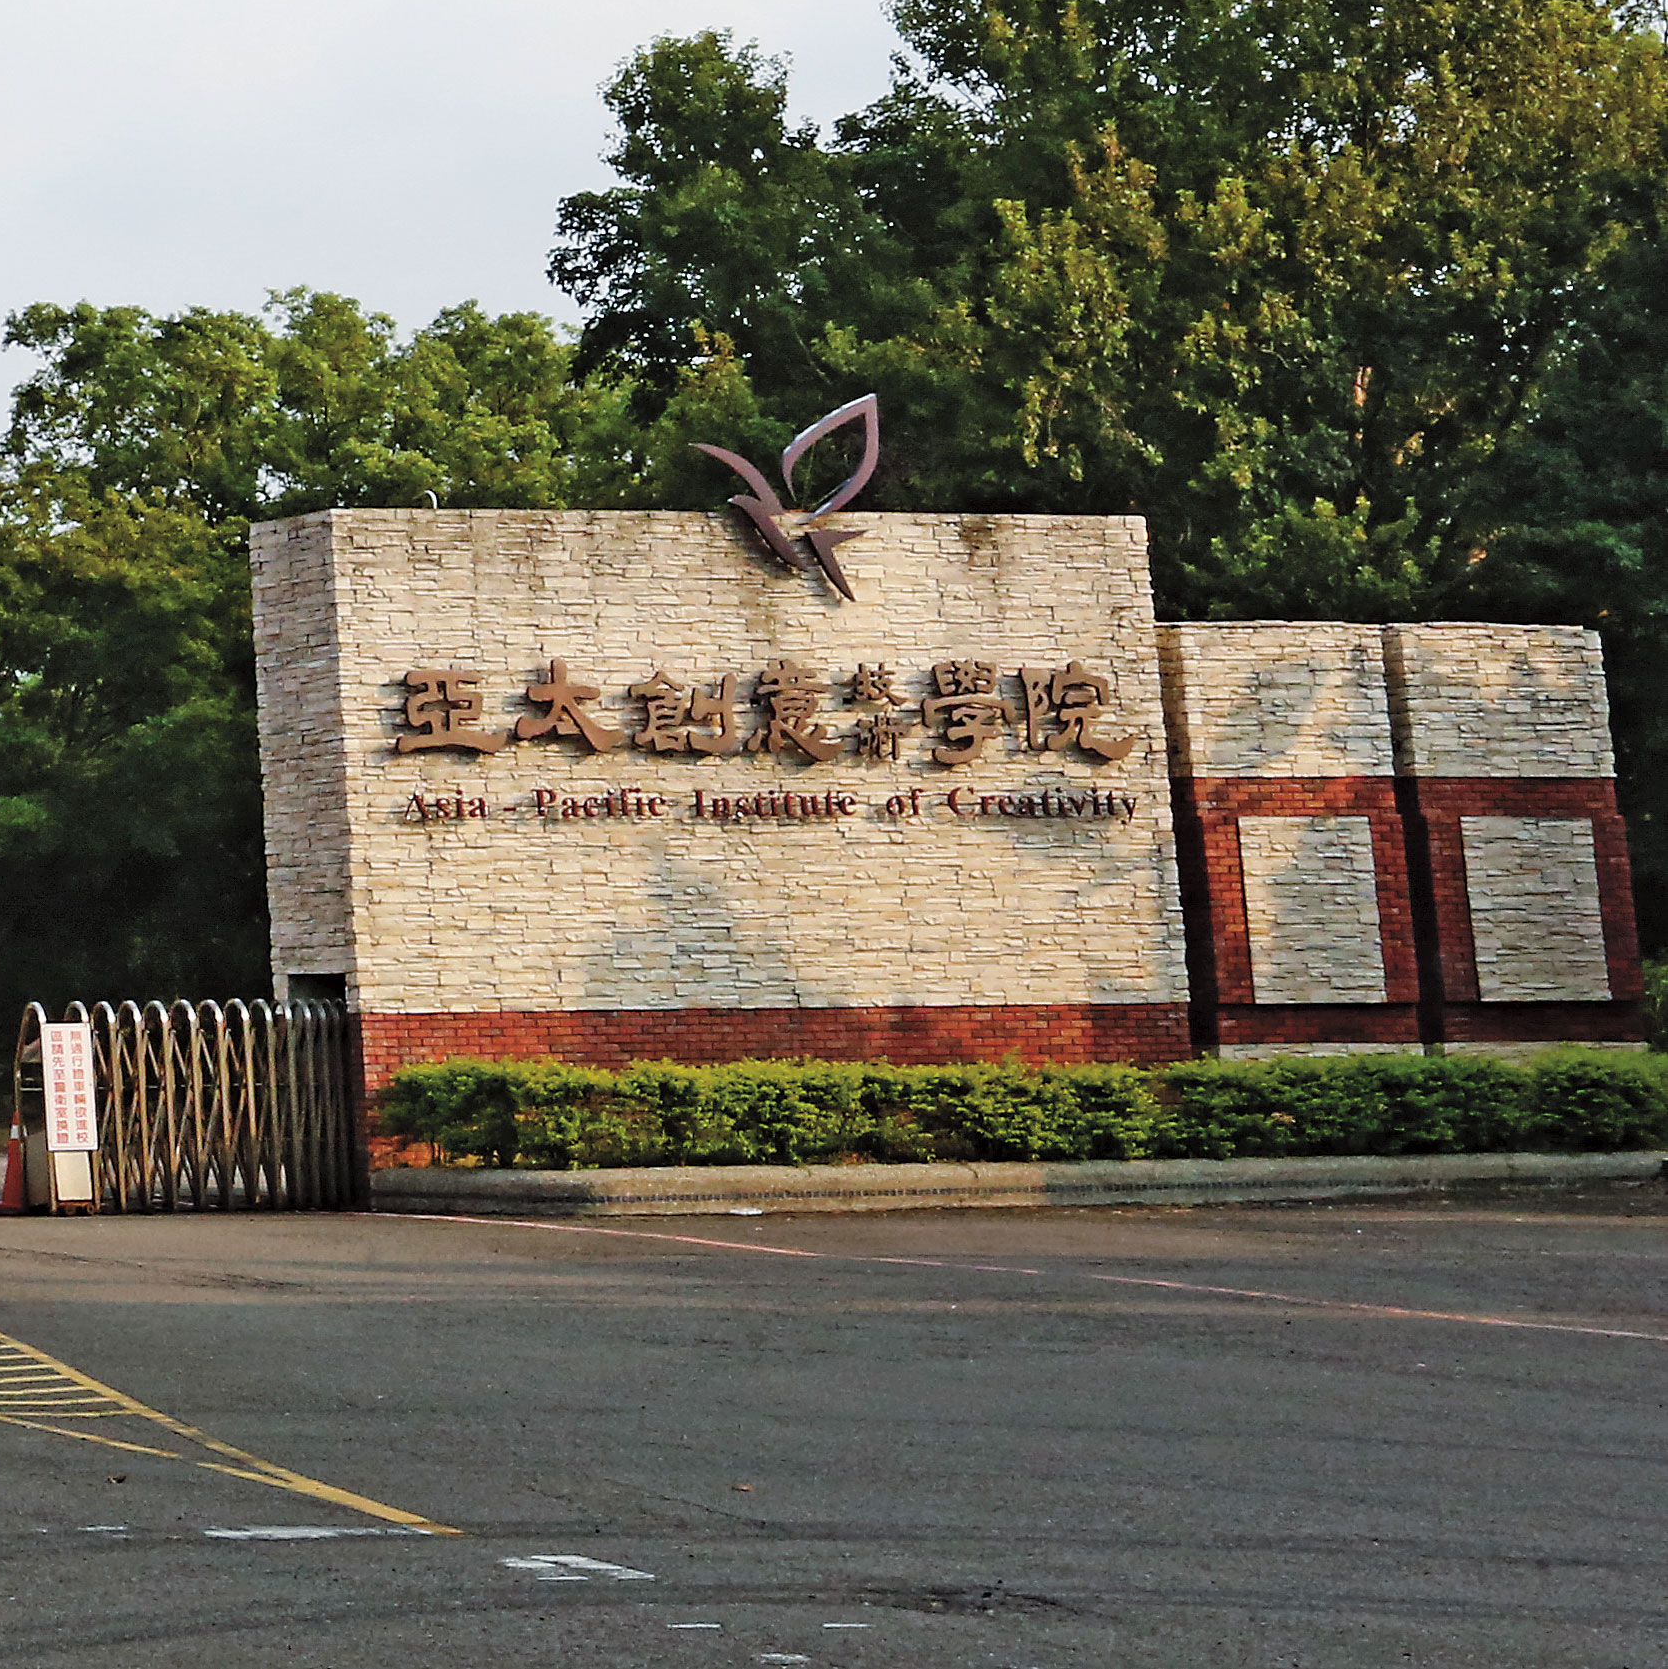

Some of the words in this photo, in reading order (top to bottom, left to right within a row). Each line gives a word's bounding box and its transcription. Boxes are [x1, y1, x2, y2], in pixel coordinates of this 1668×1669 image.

[405, 789, 490, 821] Asia
[534, 787, 667, 819] Pacific
[694, 789, 858, 819] Institute
[885, 787, 925, 818] of
[946, 786, 1138, 825] Creativity
